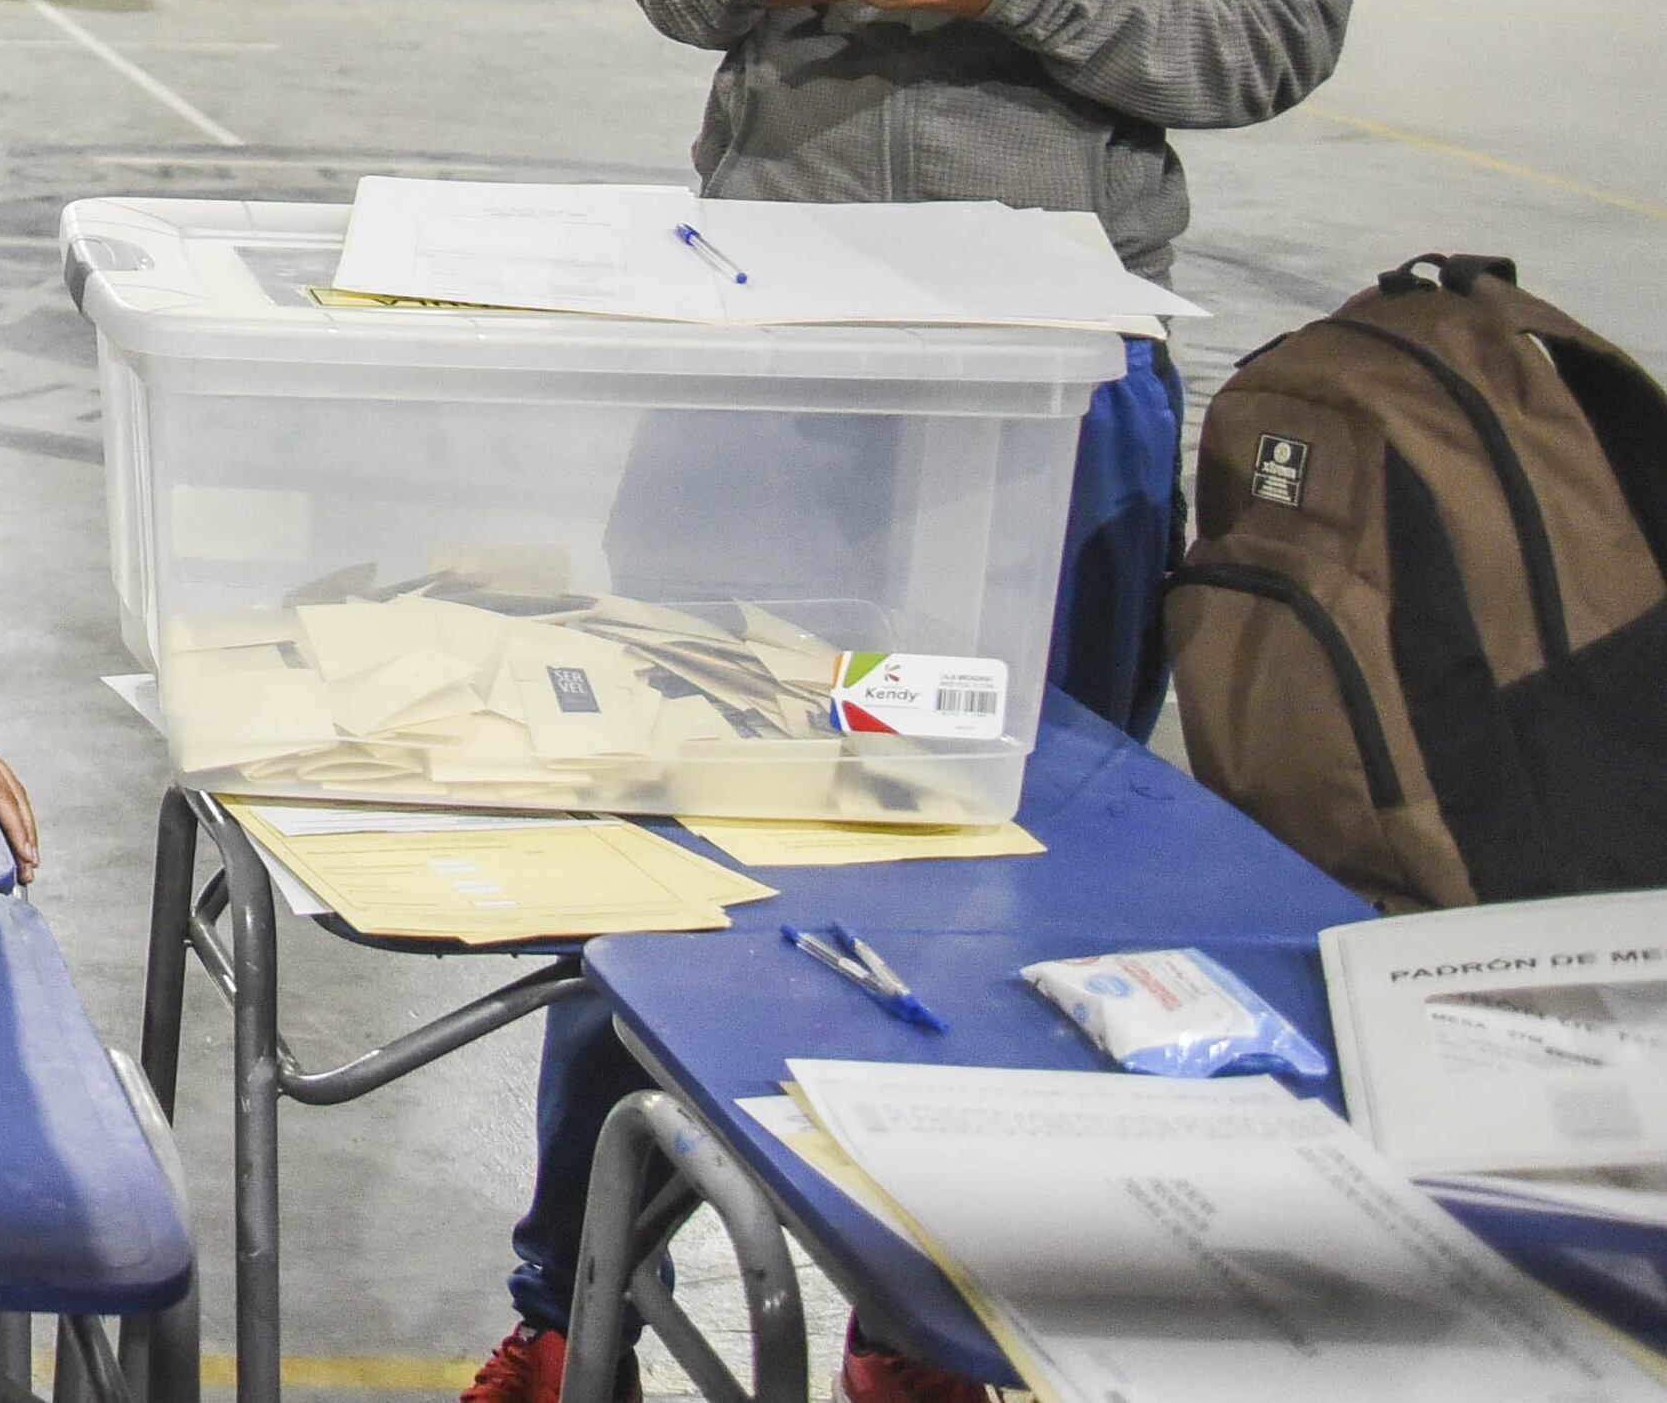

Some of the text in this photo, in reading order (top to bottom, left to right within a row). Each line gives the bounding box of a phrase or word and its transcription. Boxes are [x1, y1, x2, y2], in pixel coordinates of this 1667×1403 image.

[553, 670, 584, 683] SER
[557, 681, 586, 694] VEL
[865, 687, 918, 703] Kendy
[1390, 957, 1538, 983] PADRÓN
[1550, 952, 1596, 966] DE
